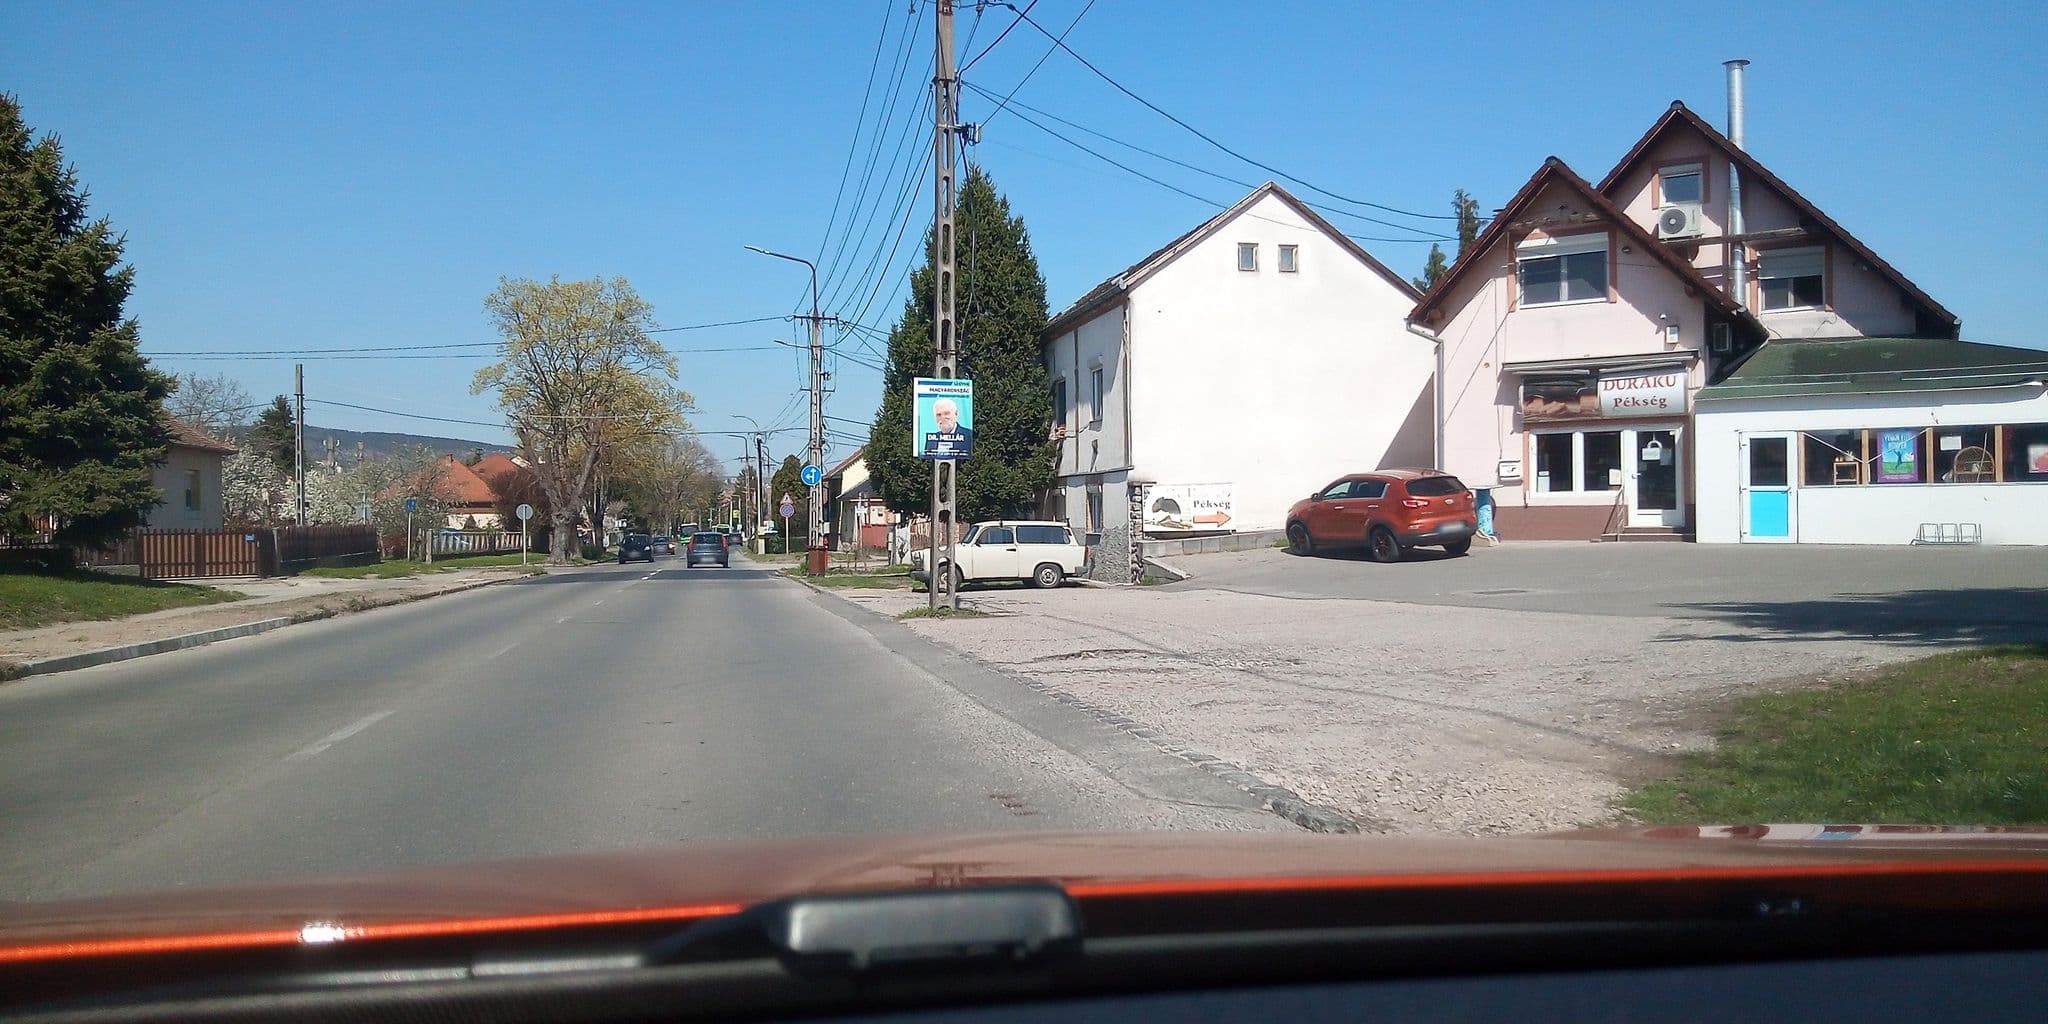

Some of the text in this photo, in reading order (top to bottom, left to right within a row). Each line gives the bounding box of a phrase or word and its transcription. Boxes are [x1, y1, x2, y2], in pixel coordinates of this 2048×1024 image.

[1603, 375, 1677, 391] DURAKU
[1613, 395, 1668, 409] Pékség
[940, 433, 965, 442] MELLÁR
